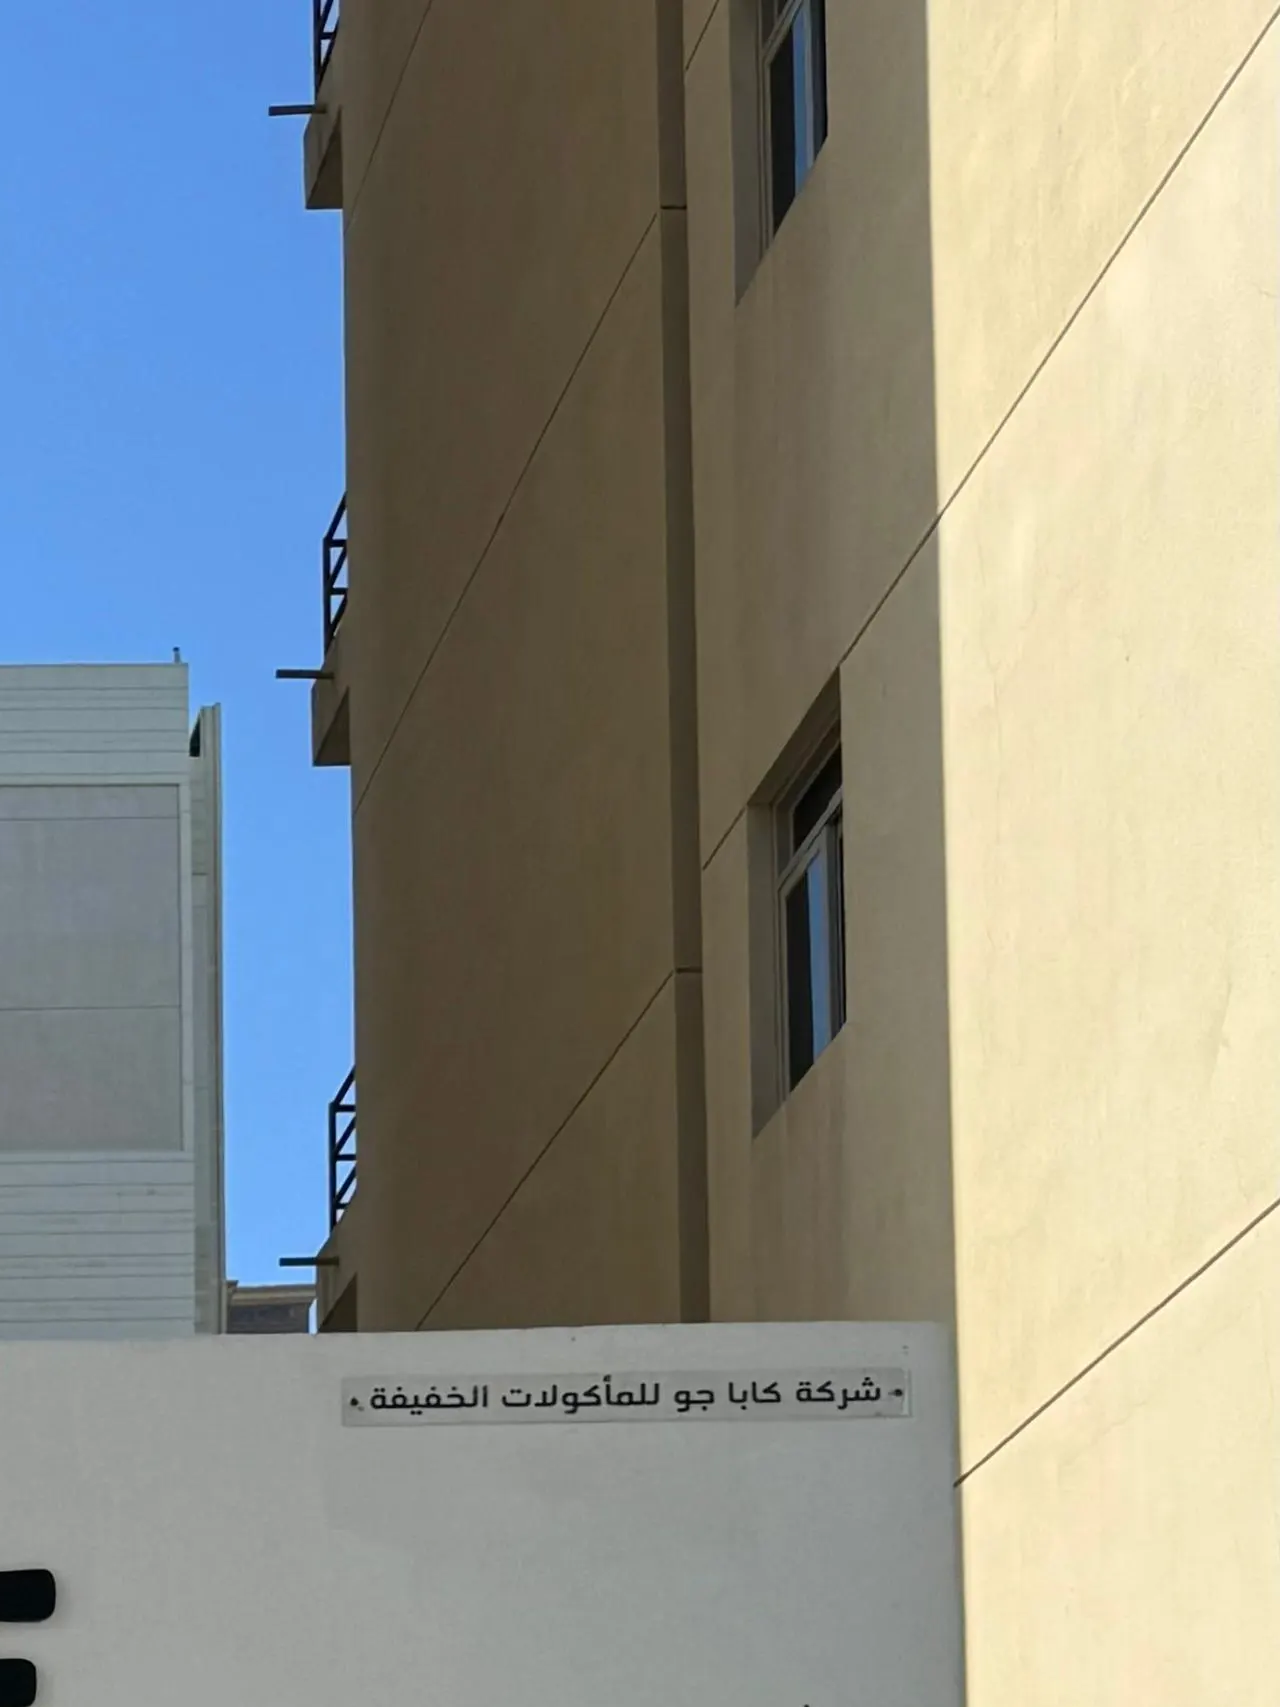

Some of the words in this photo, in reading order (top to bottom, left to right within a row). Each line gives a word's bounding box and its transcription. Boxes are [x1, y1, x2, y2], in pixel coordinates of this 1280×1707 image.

[370, 1384, 489, 1416] الخفيفة
[501, 1374, 660, 1414] للمأكولات
[673, 1389, 715, 1412] جو
[728, 1381, 782, 1410] كابا
[795, 1377, 881, 1410] شركة
